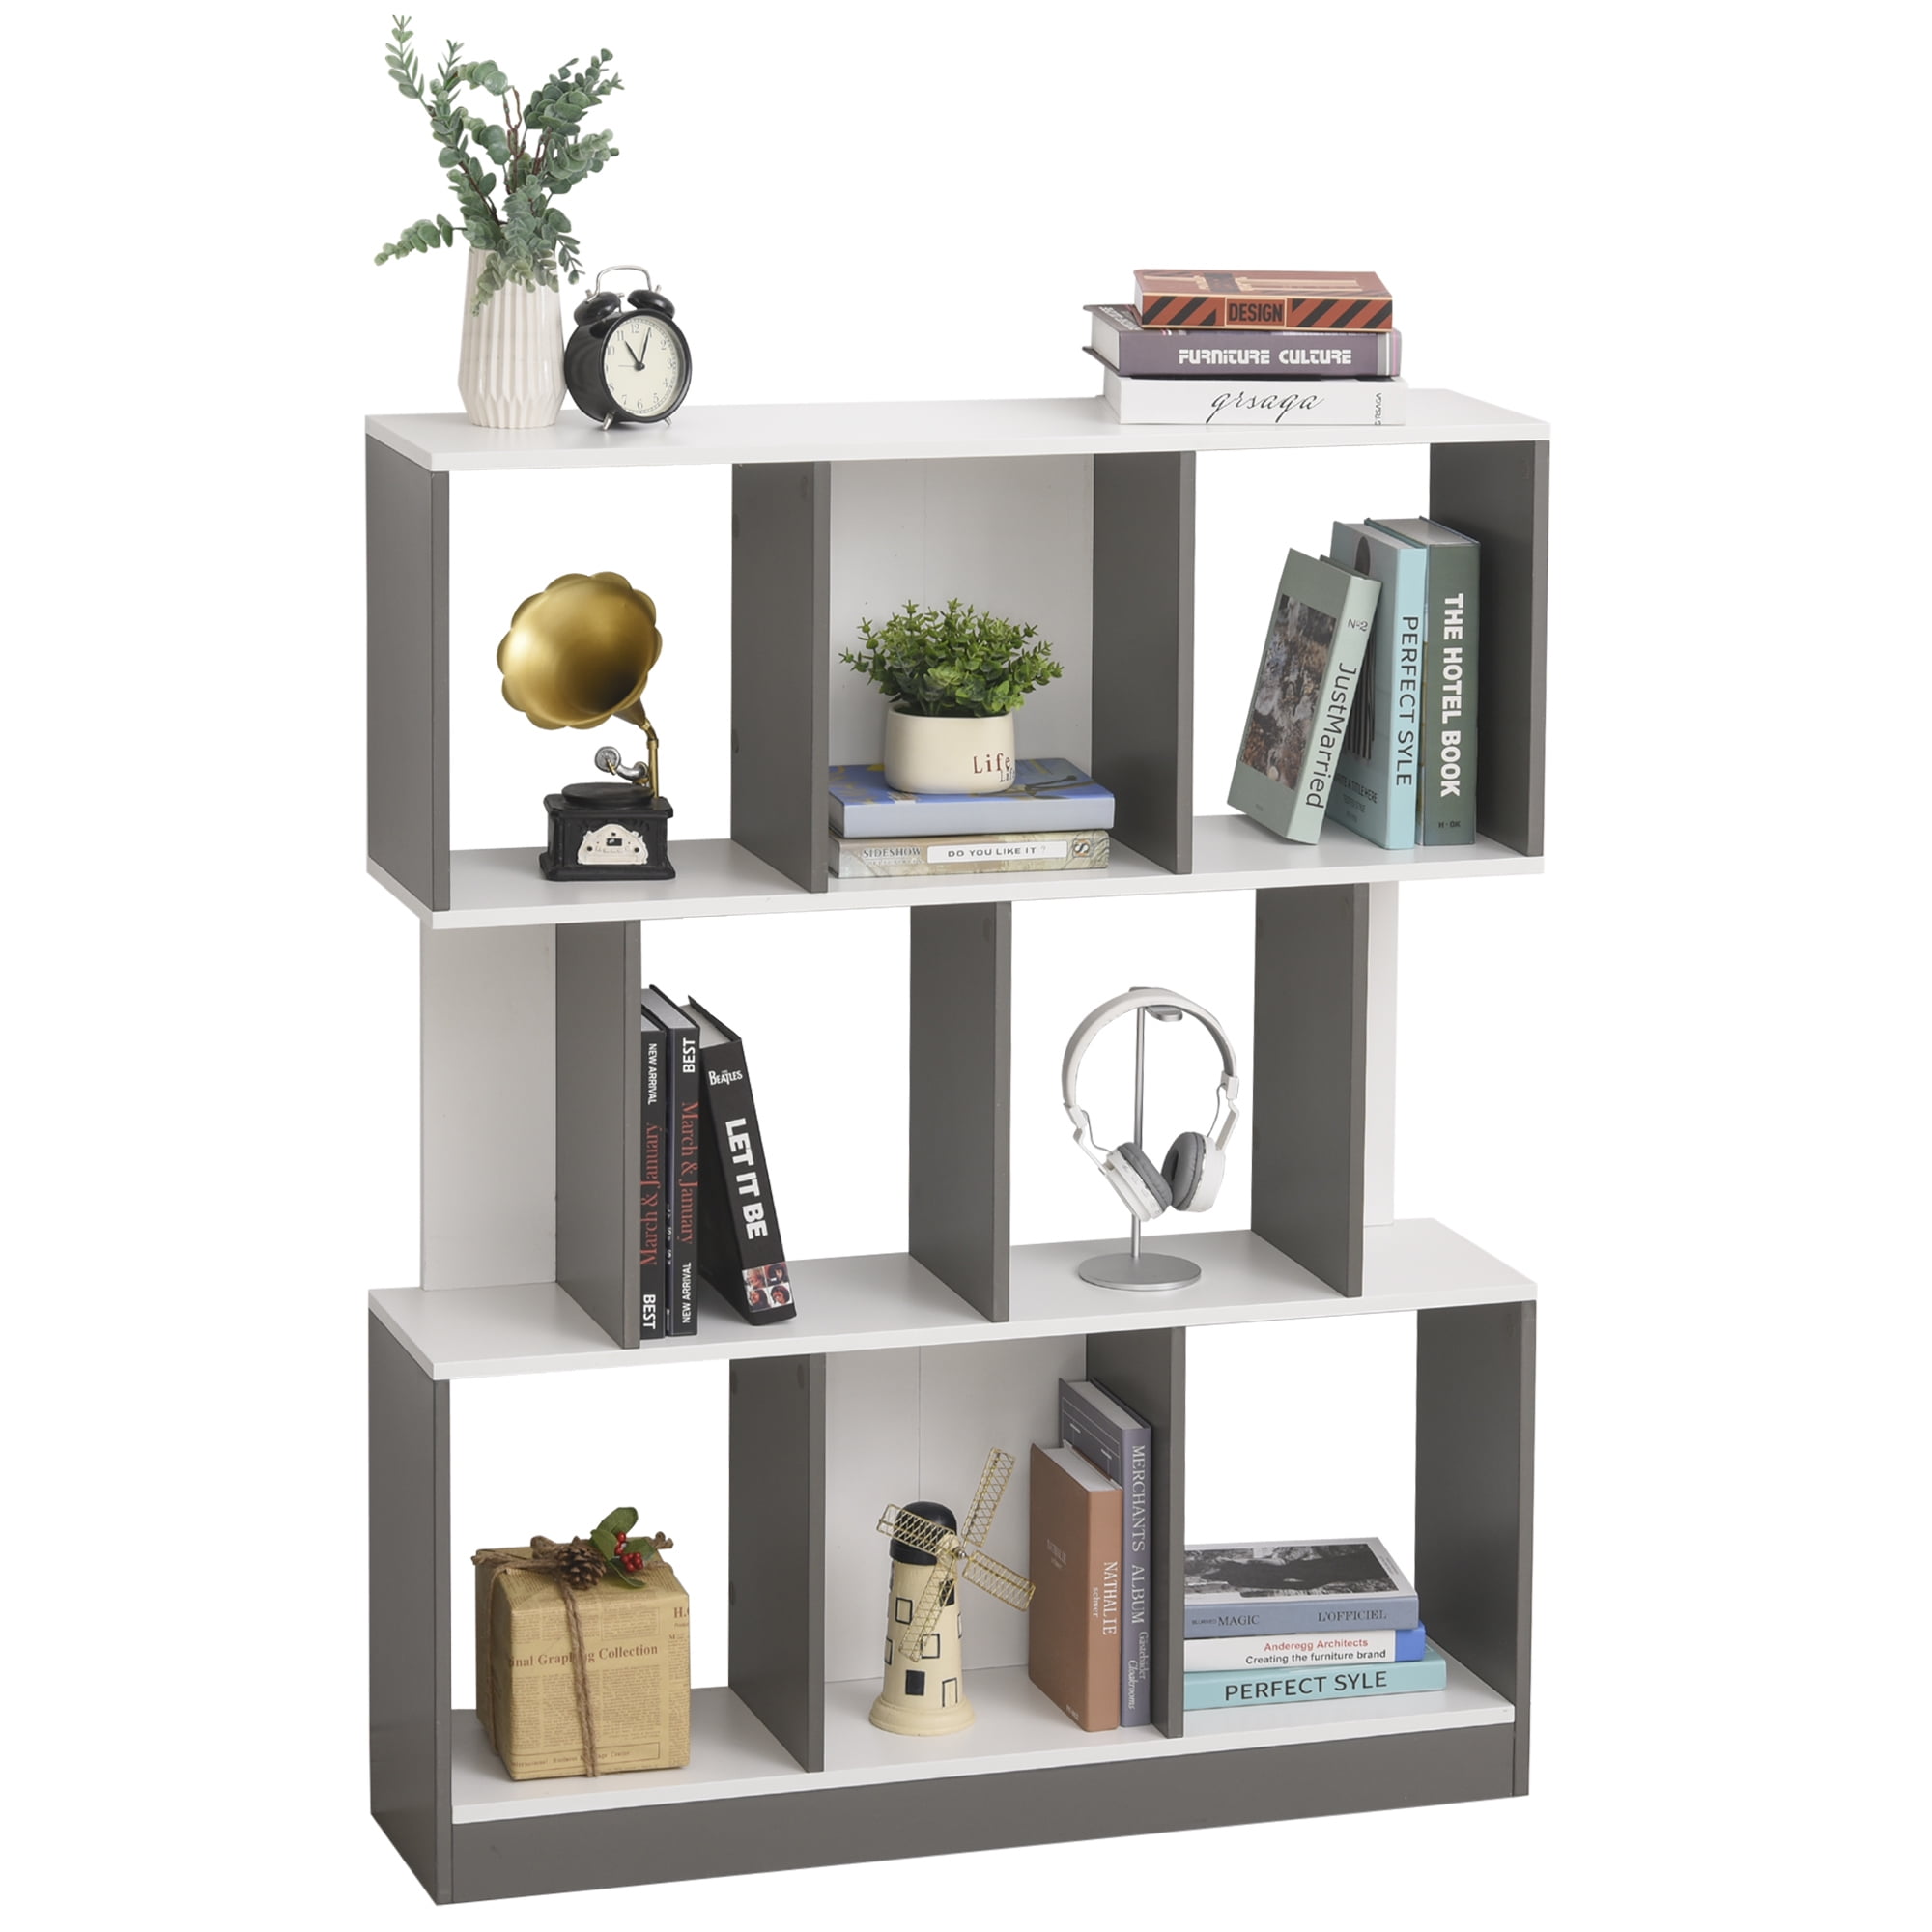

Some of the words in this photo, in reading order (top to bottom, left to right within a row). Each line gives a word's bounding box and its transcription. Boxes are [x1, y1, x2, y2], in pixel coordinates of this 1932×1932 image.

[1228, 303, 1283, 322] DESIGN
[616, 330, 624, 341] 11
[631, 324, 639, 334] 12
[1178, 348, 1271, 365] FURNITURE
[1278, 348, 1353, 365] CULTURE
[1443, 592, 1464, 640] THE
[1398, 615, 1419, 722] PERFECT
[1441, 647, 1463, 724] HOTEL
[973, 753, 1011, 774] Life
[1396, 729, 1414, 786] SYLE
[1440, 730, 1462, 798] BOOK
[863, 847, 921, 858] SIDESHOW
[996, 847, 1021, 856] LIKE
[1025, 846, 1037, 855] IT
[647, 1043, 658, 1065] NEW
[682, 1037, 696, 1073] BEST
[647, 1065, 658, 1106] ARRIVAL
[681, 1101, 699, 1157] March
[725, 1118, 755, 1167] LET
[640, 1122, 663, 1189] January
[681, 1161, 698, 1176] &
[641, 1193, 658, 1207] &
[735, 1172, 761, 1198] IT
[677, 1179, 699, 1245] January
[742, 1202, 769, 1240] BE
[640, 1208, 658, 1265] March
[682, 1262, 692, 1300] ARRIVAL
[642, 1293, 657, 1330] BEST
[682, 1301, 692, 1324] NEW
[1131, 1444, 1147, 1552] MERCHANTS
[1131, 1565, 1146, 1625] ALBUM
[1217, 1614, 1260, 1627] MAGIC
[1317, 1608, 1387, 1623] L'OFFICIEL
[599, 1643, 658, 1660] Collection
[1245, 1654, 1289, 1664] Creating
[1292, 1653, 1308, 1662] the
[1310, 1652, 1354, 1662] furniture
[1356, 1650, 1386, 1660] brand
[1264, 1641, 1314, 1651] Anderegg
[1317, 1639, 1369, 1649] Architects
[1225, 1675, 1327, 1701] PERFECT
[1334, 1671, 1387, 1691] SYLE
